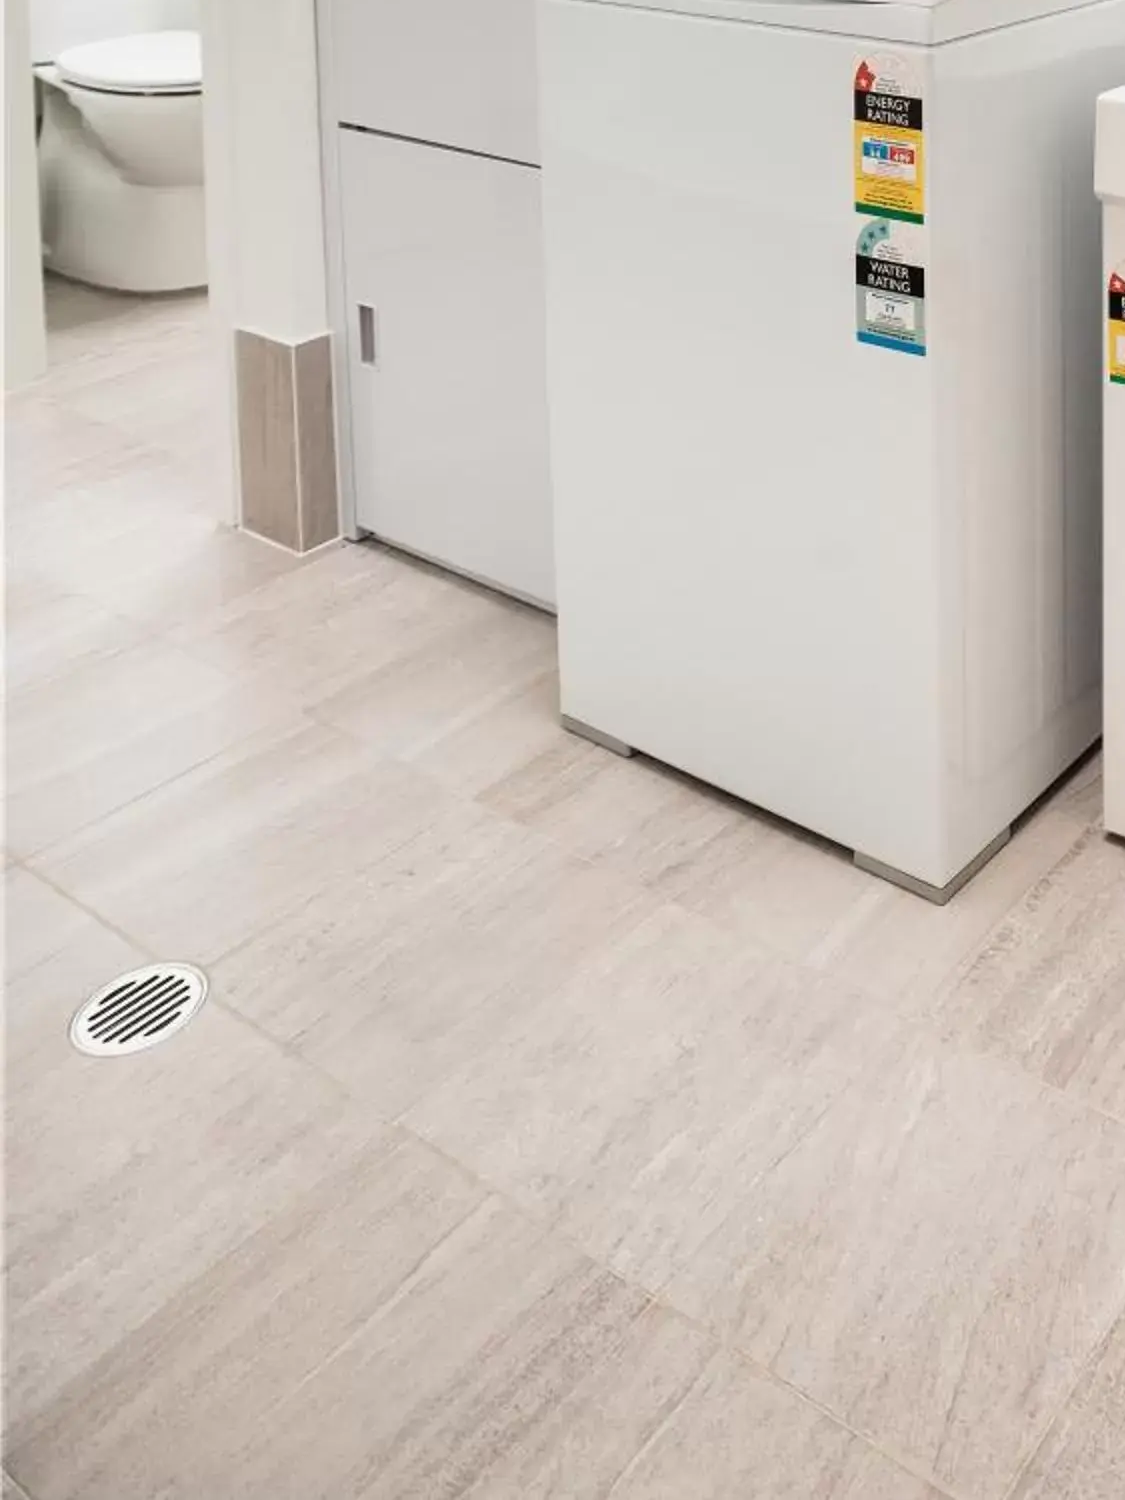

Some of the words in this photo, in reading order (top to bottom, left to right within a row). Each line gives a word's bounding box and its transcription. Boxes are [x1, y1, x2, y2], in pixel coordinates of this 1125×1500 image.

[866, 94, 911, 111] ENERGY
[867, 109, 909, 126] RATING
[869, 260, 909, 279] WATER
[868, 273, 911, 292] RATING
